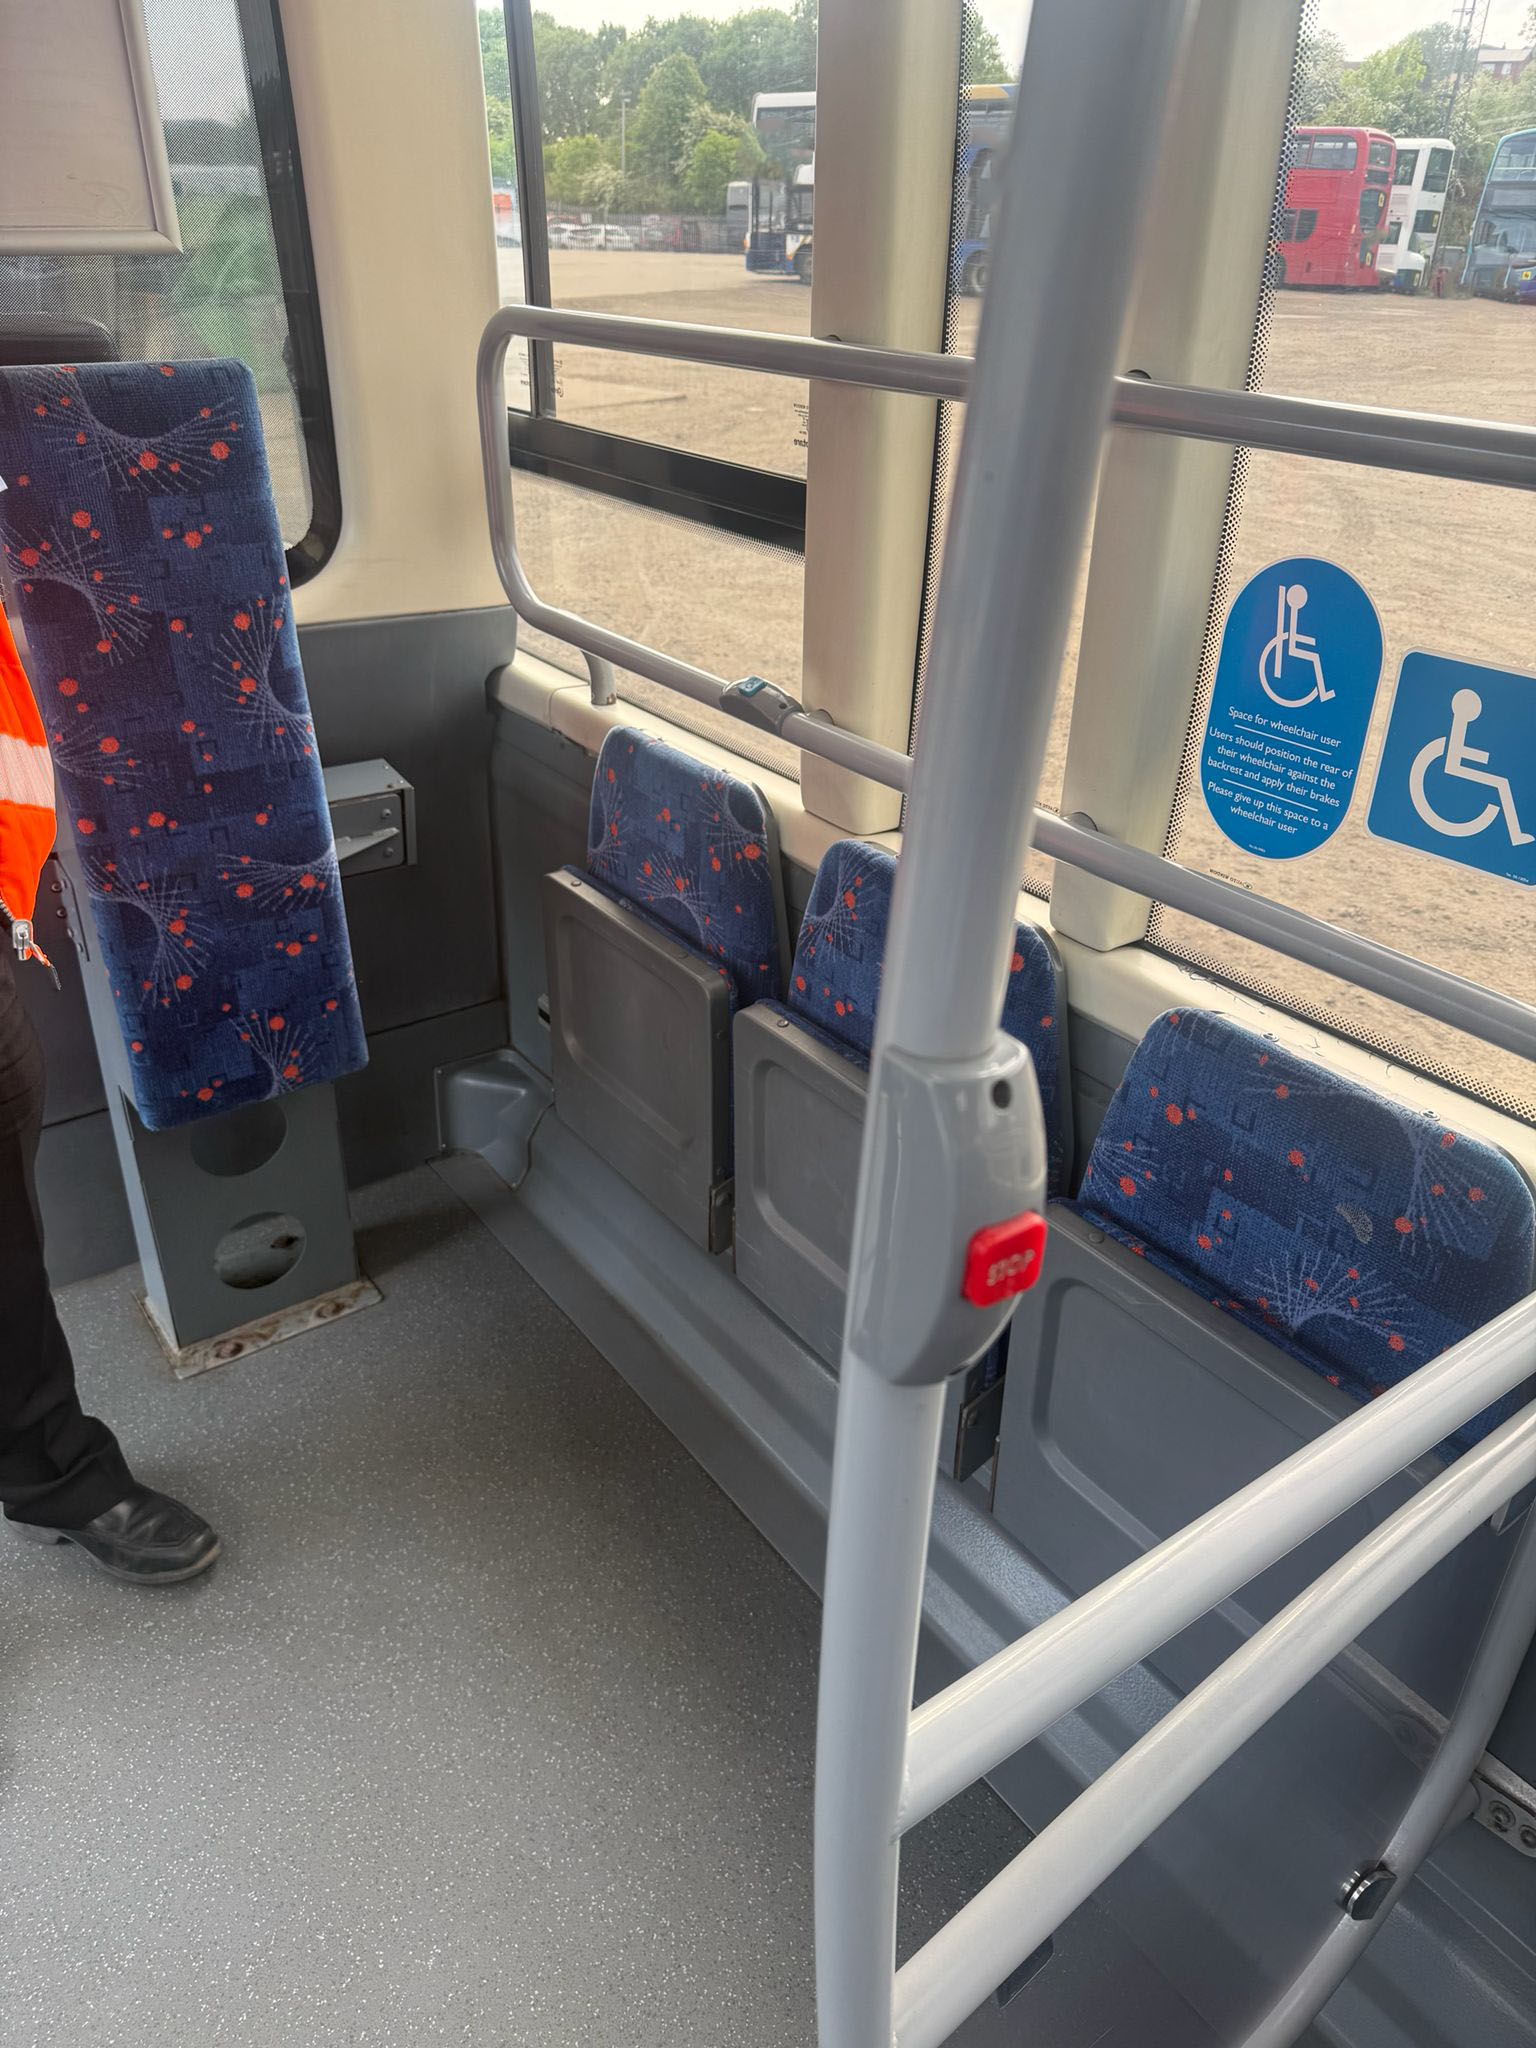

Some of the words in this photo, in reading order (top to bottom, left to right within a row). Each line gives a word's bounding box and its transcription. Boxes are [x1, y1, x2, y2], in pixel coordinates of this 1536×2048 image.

[1228, 706, 1253, 721] Space
[1254, 714, 1268, 725] for
[1270, 720, 1319, 741] wheelchair
[1320, 735, 1341, 748] user
[1209, 726, 1233, 741] Users
[1235, 736, 1264, 751] should
[1264, 746, 1301, 762] position
[1303, 756, 1318, 768] the
[1320, 763, 1340, 774] rear
[1341, 769, 1354, 779] of
[1217, 745, 1238, 758] their
[1240, 753, 1286, 773] wheelchair
[1287, 768, 1319, 784] against
[1320, 777, 1336, 790] the
[1207, 756, 1243, 775] backrest
[1244, 770, 1260, 781] and
[1261, 776, 1285, 791] apply
[1286, 783, 1308, 796] their
[1309, 789, 1340, 807] brakes
[1207, 781, 1233, 797] Please
[1234, 792, 1251, 802] give
[1253, 799, 1264, 809] up
[1266, 802, 1282, 814] this
[1283, 809, 1308, 823] space
[1311, 818, 1321, 827] to
[1230, 805, 1276, 827] wheelchair
[1277, 822, 1298, 834] user
